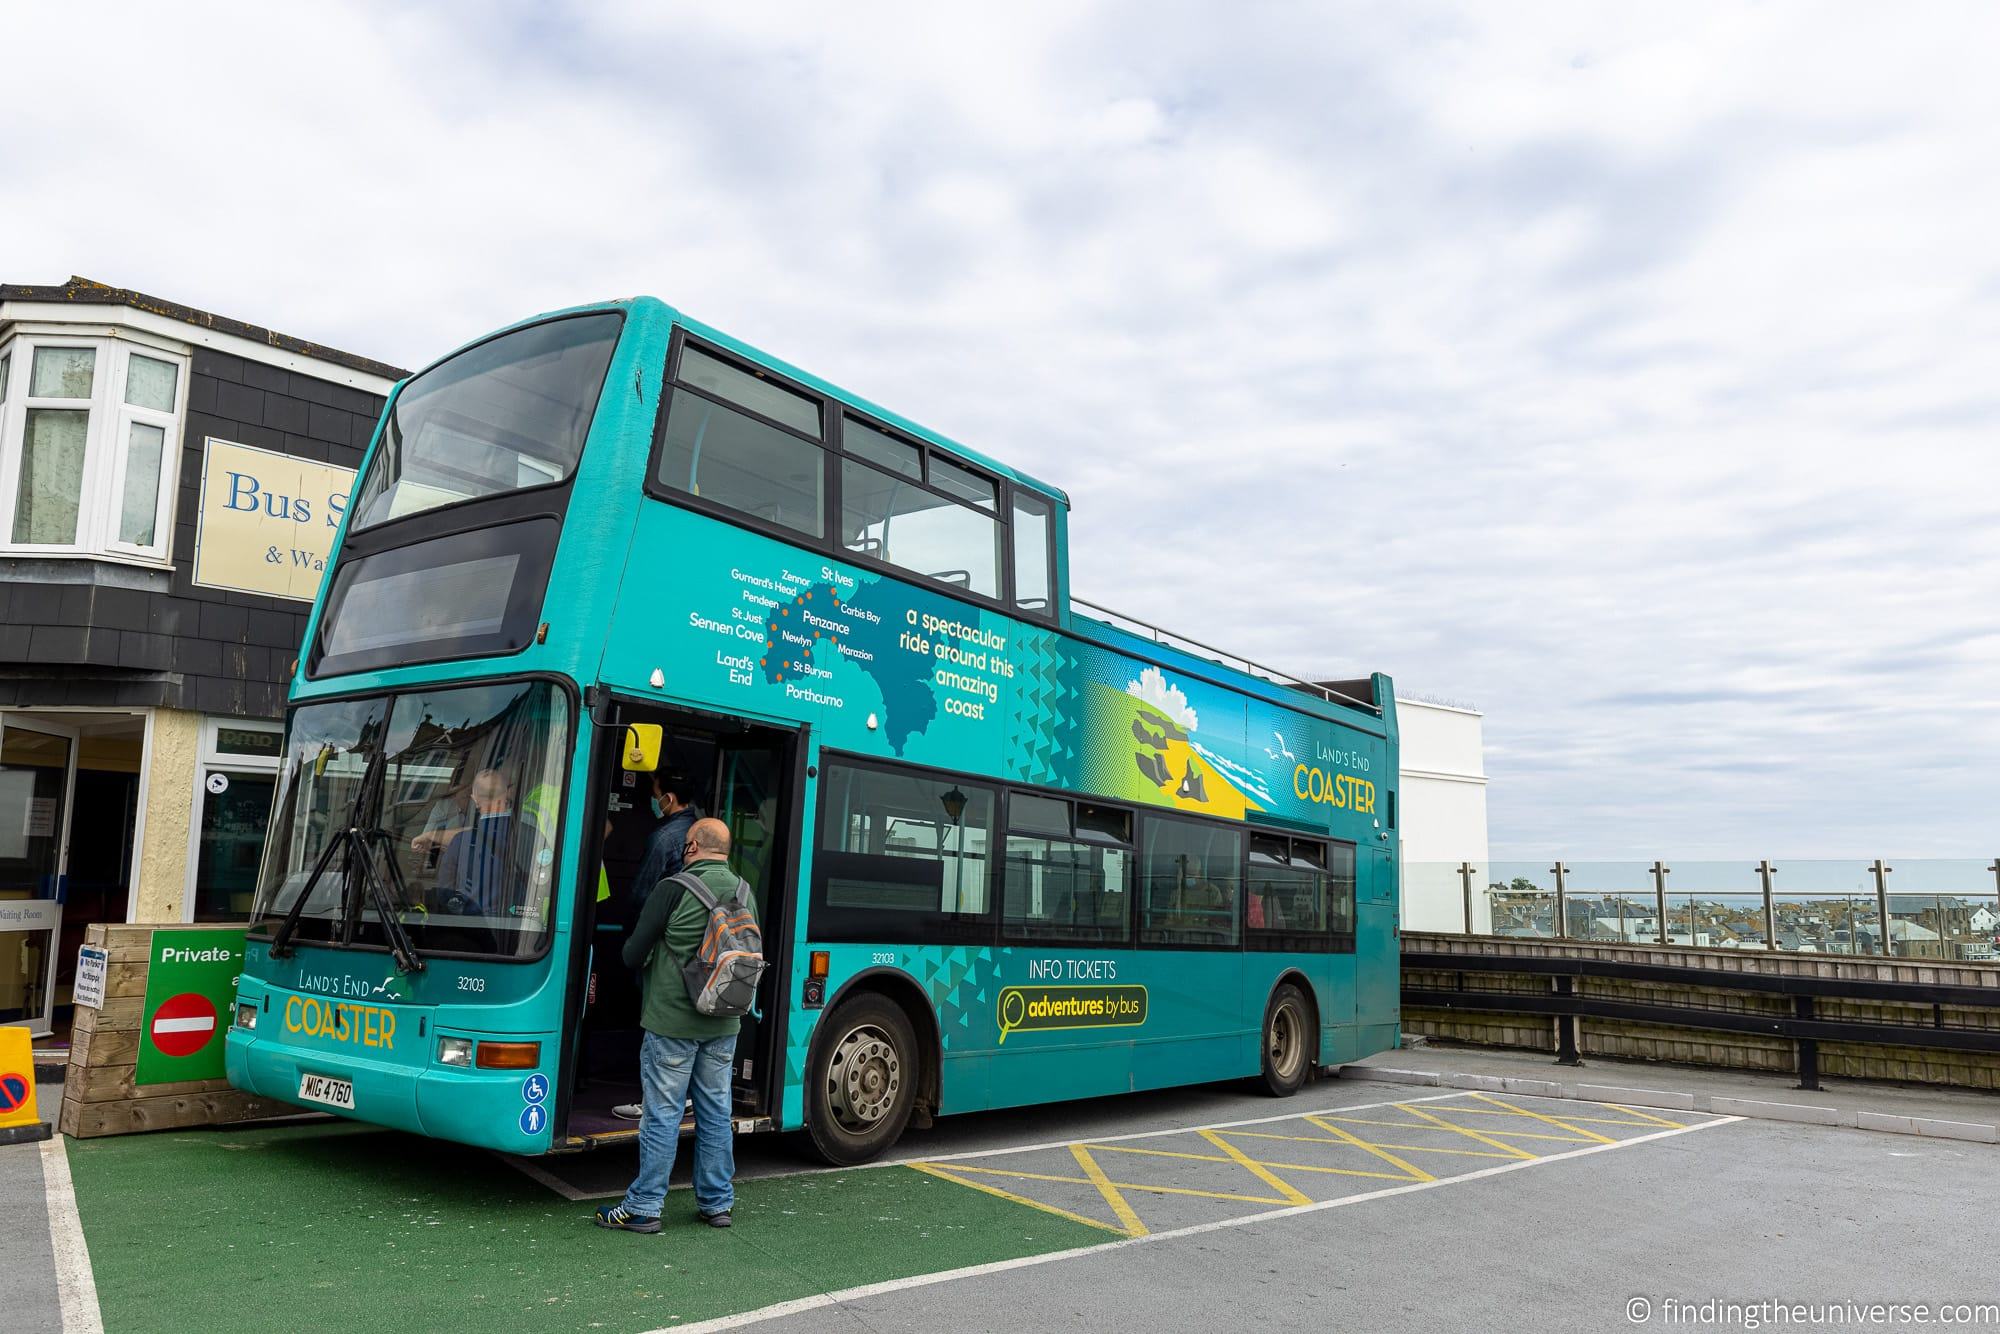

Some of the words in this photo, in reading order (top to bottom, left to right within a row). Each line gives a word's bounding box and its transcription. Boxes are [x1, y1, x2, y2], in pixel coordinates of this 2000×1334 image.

[223, 471, 311, 523] Bus
[327, 493, 349, 528] S
[265, 545, 283, 564] &
[731, 568, 773, 590] Gurnard's
[775, 582, 797, 597] Head
[782, 569, 812, 587] Zennor
[821, 566, 833, 580] St
[835, 570, 854, 588] Ives
[743, 590, 779, 609] Pendeen
[732, 608, 742, 619] St
[743, 610, 763, 625] Just
[803, 610, 850, 635] Penzance
[841, 604, 865, 619] Carbis
[866, 609, 881, 625] Bay
[689, 612, 733, 636] Sennen
[736, 624, 764, 643] Cove
[907, 609, 918, 625] a
[922, 613, 1006, 651] spectacular
[782, 630, 812, 648] Newlyn
[717, 650, 754, 671] Land's
[838, 643, 873, 661] Marazion
[900, 631, 930, 655] ride
[934, 643, 987, 671] around
[990, 656, 1014, 678] this
[729, 670, 753, 686] End
[793, 661, 803, 672] St
[804, 663, 833, 680] Buryan
[786, 684, 843, 708] Porthcurno
[936, 670, 998, 704] amazing
[945, 698, 985, 721] coast
[1316, 741, 1349, 767] LAND'S
[1351, 751, 1370, 772] END
[1293, 763, 1376, 815] COASTER
[161, 947, 230, 963] Private
[872, 952, 895, 964] 32103
[1029, 959, 1063, 979] INFO
[1066, 960, 1117, 979] TICKETS
[299, 969, 339, 994] LAND'S
[344, 974, 370, 998] END
[457, 976, 485, 992] 32103
[1028, 994, 1104, 1018] adventures
[1105, 994, 1119, 1019] by
[1120, 994, 1140, 1014] bus
[285, 995, 396, 1050] COASTER
[305, 1076, 323, 1098] MIG
[324, 1080, 352, 1104] 4760
